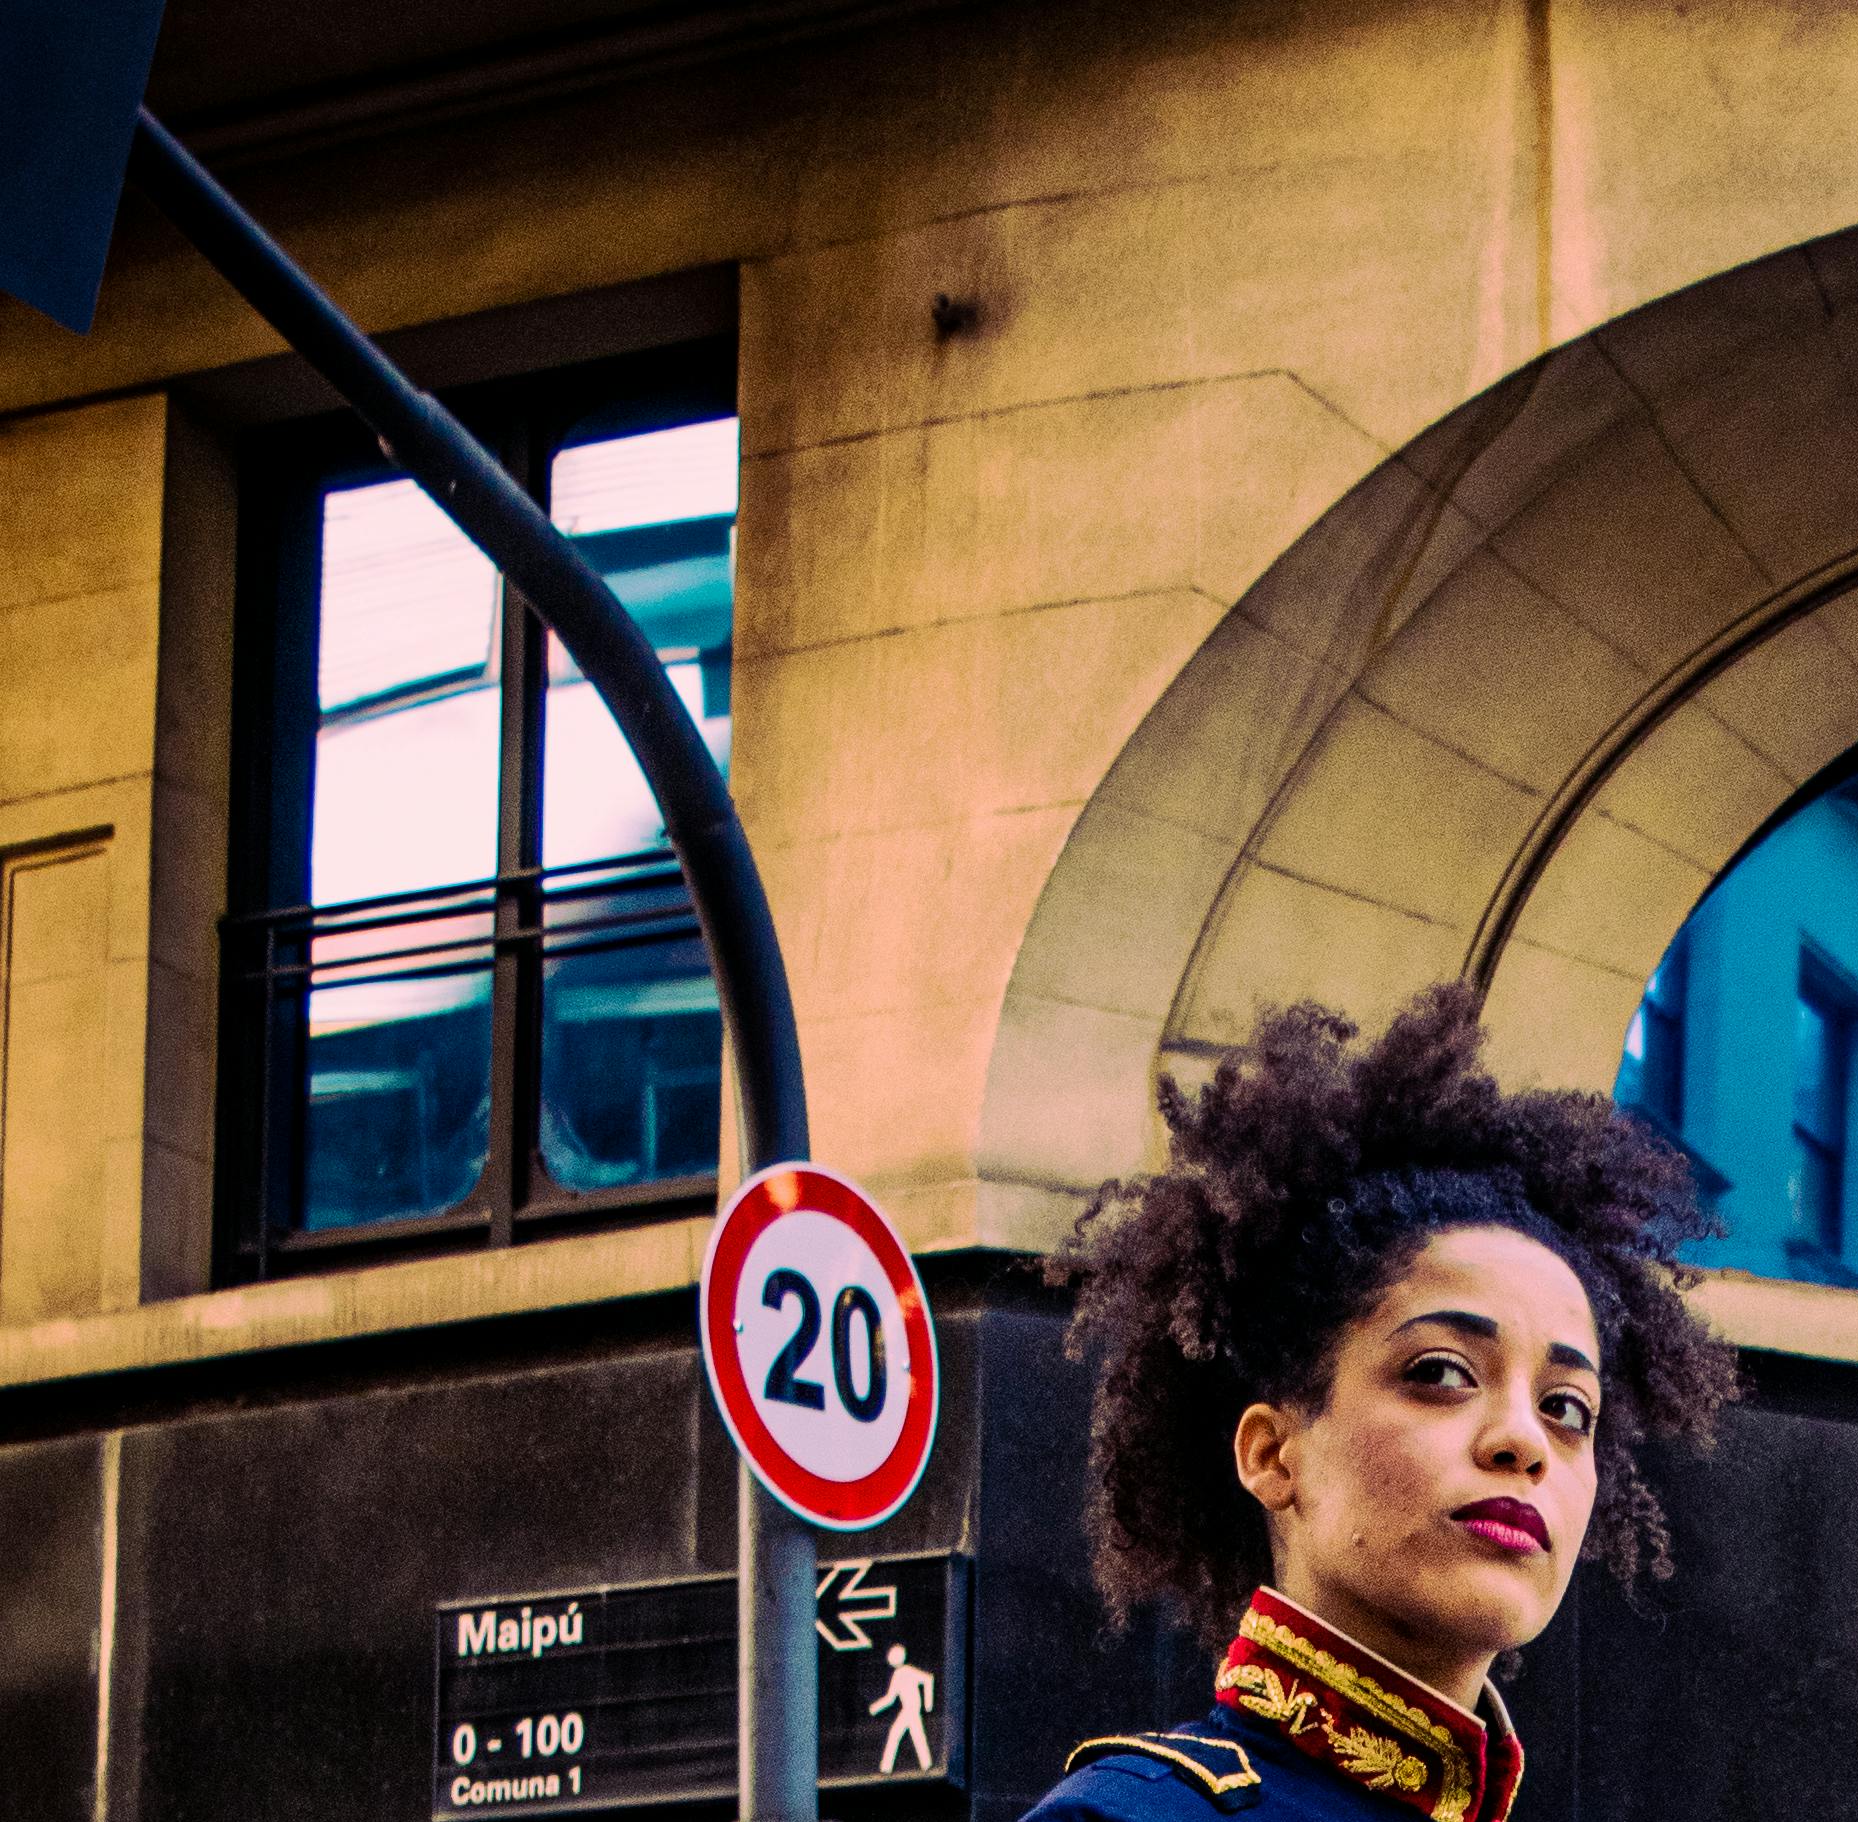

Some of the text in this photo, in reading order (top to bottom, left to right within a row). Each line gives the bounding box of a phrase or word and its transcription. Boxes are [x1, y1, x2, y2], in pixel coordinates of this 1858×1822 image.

[761, 1267, 888, 1423] 20
[458, 1602, 583, 1657] Maipú
[453, 1723, 476, 1765] 0
[516, 1713, 584, 1758] 100
[451, 1767, 581, 1805] Comuna 1
